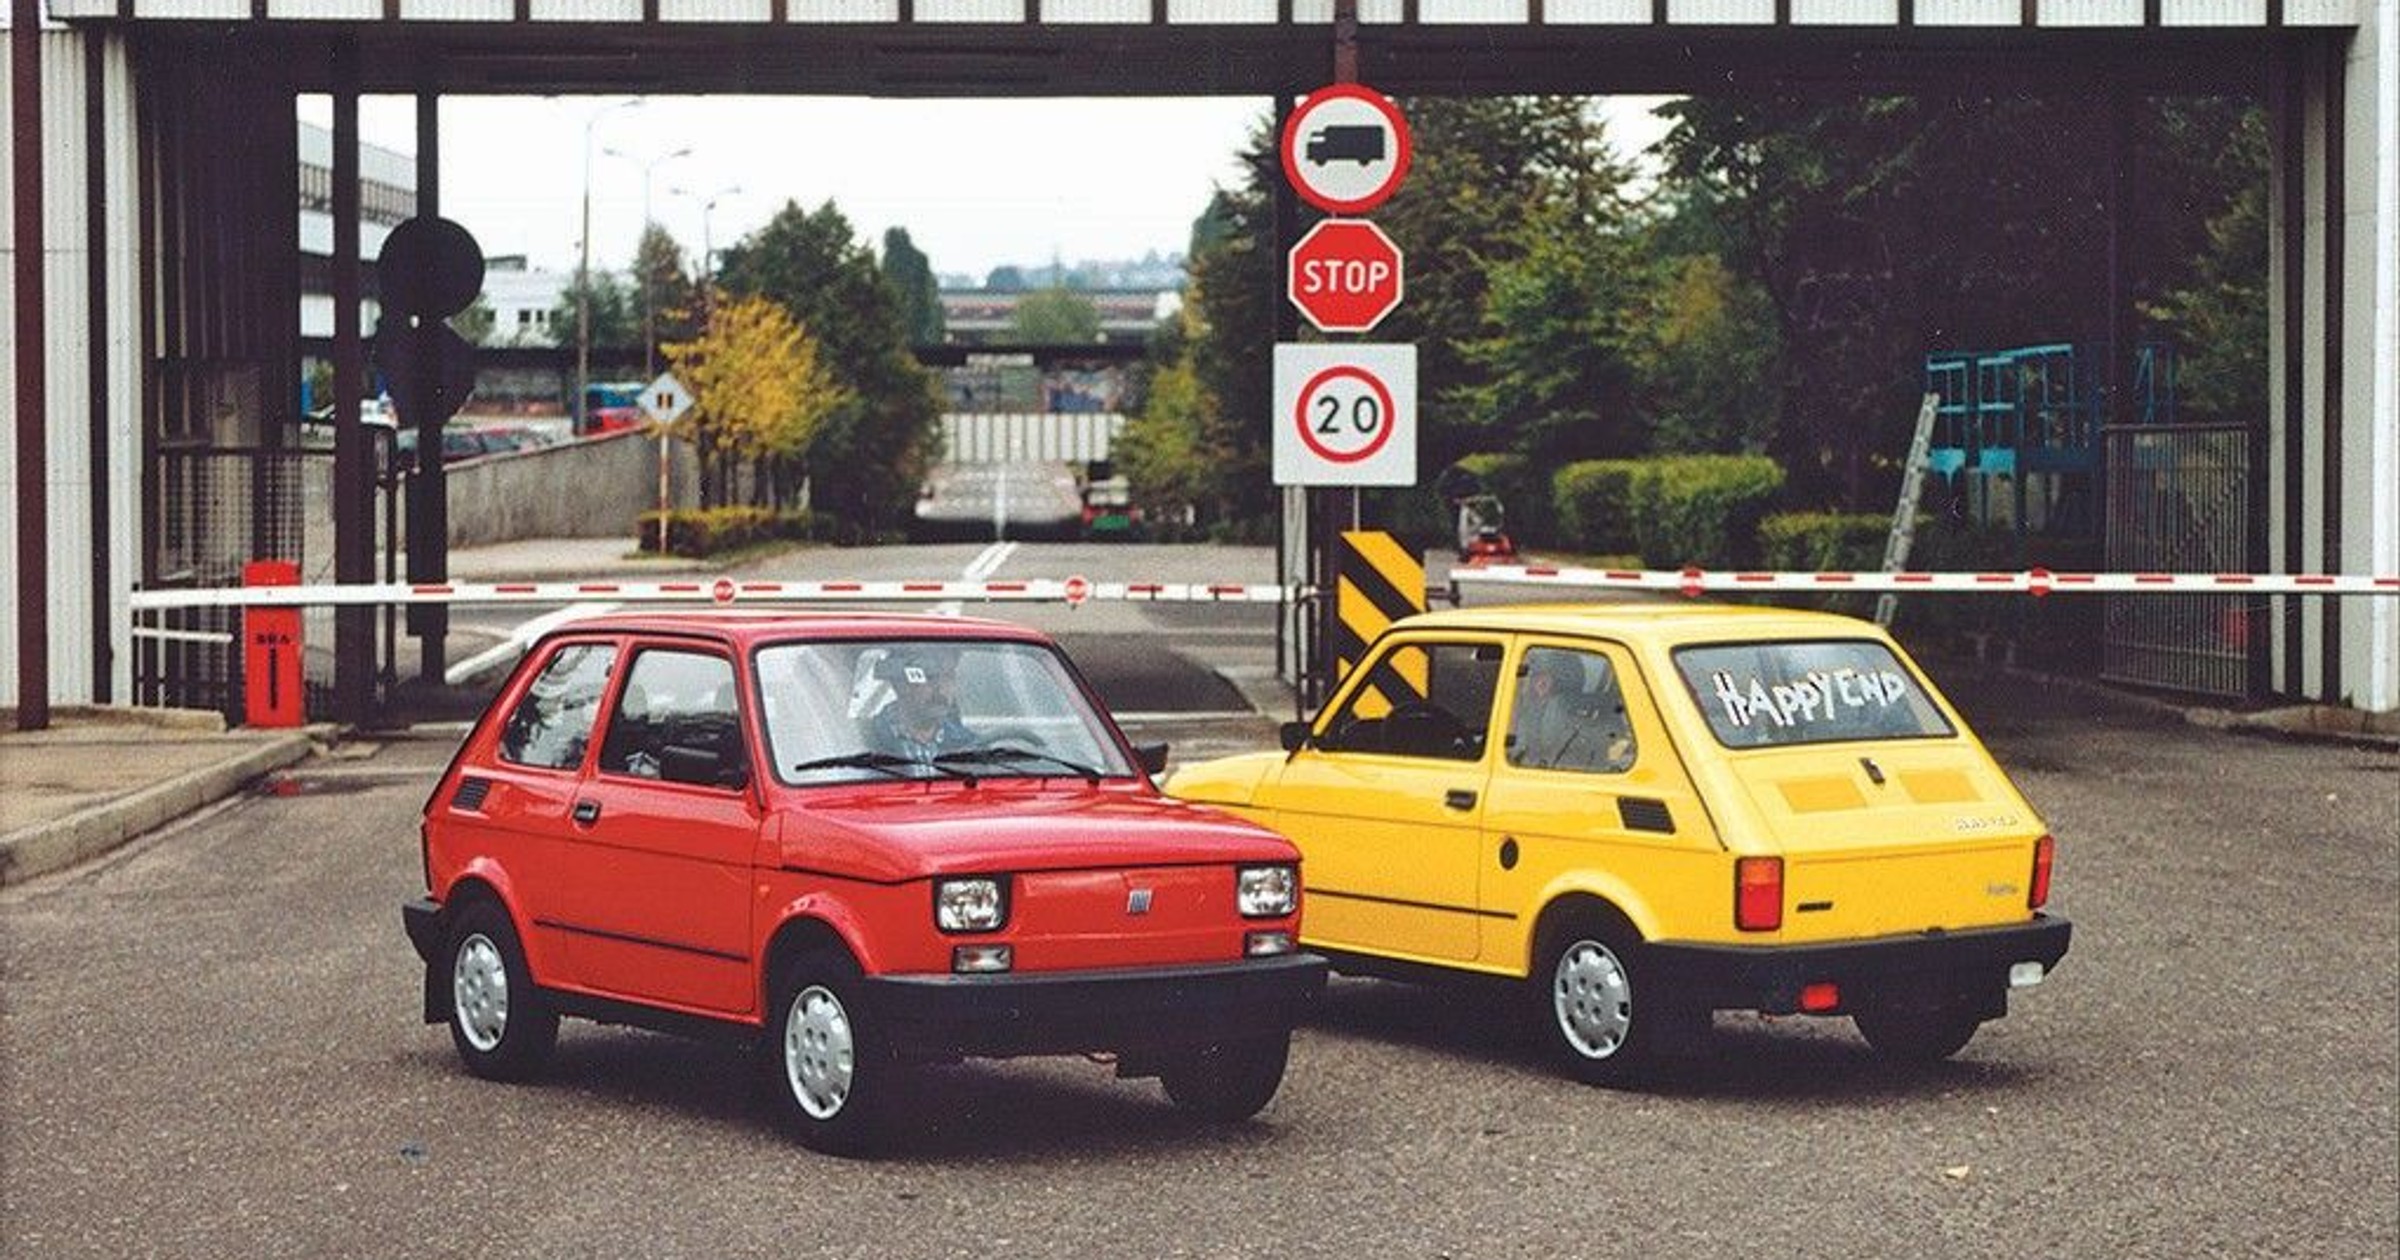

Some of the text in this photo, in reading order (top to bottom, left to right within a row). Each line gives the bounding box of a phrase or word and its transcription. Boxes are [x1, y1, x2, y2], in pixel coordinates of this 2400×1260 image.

[1303, 259, 1390, 294] STOP
[1316, 394, 1379, 434] 20
[1713, 667, 1906, 726] HAPPY END
